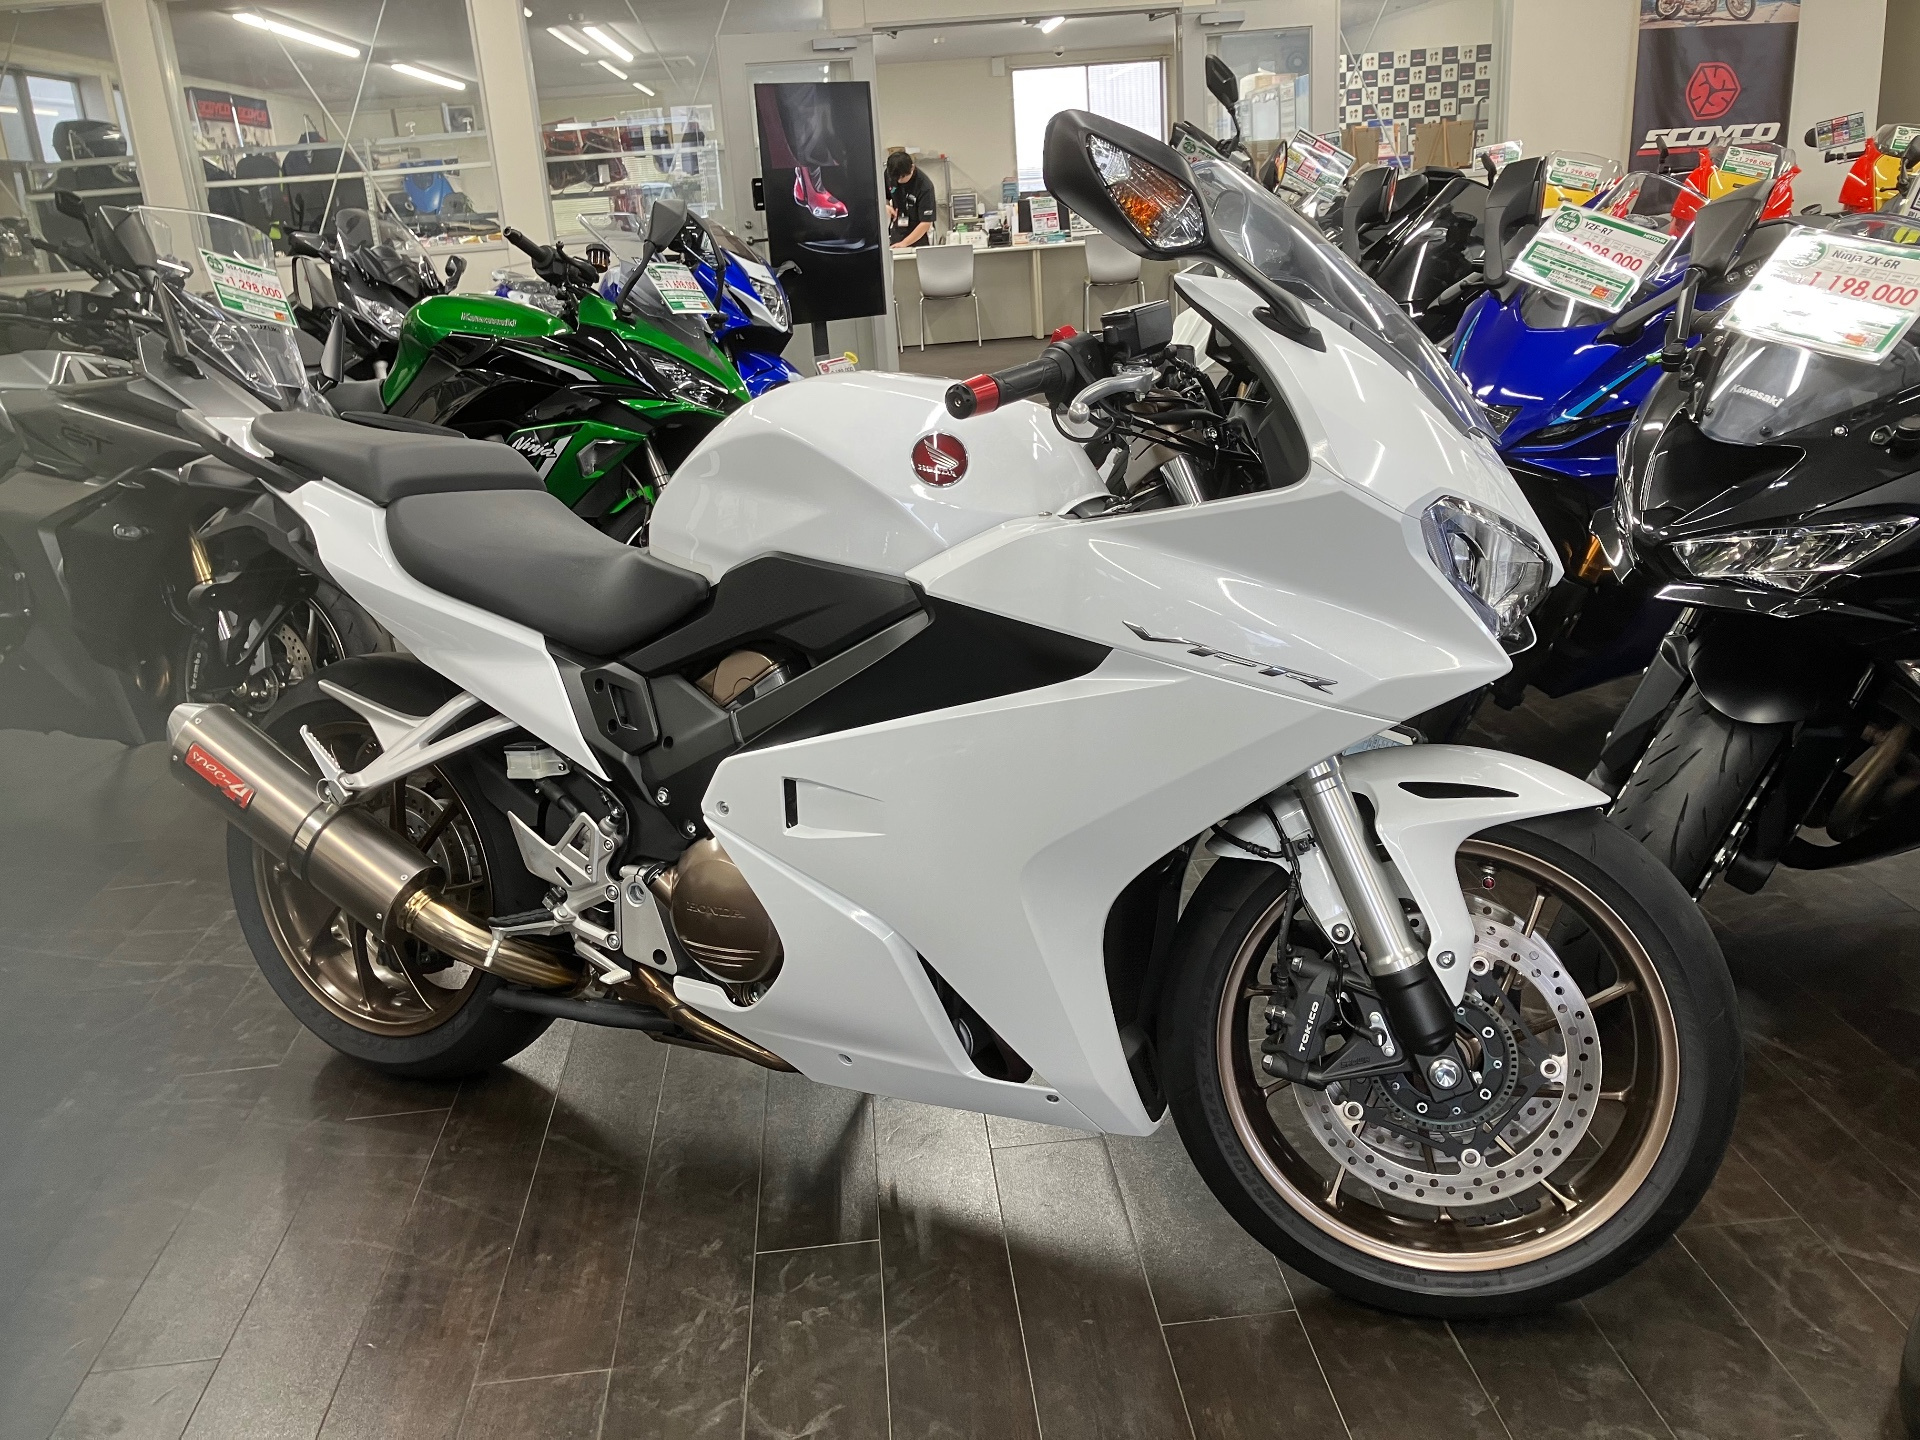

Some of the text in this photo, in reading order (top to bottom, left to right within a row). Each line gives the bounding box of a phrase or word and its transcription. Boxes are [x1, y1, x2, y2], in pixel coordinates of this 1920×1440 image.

[1639, 122, 1781, 150] SCOYCO
[1584, 220, 1614, 237] YZF-R7
[1831, 249, 1902, 270] Ninja ZX-6R
[1729, 384, 1785, 408] Kawasaki
[511, 436, 557, 457] Ninja
[190, 652, 202, 690] brembo
[1298, 1001, 1320, 1053] TOKICO
